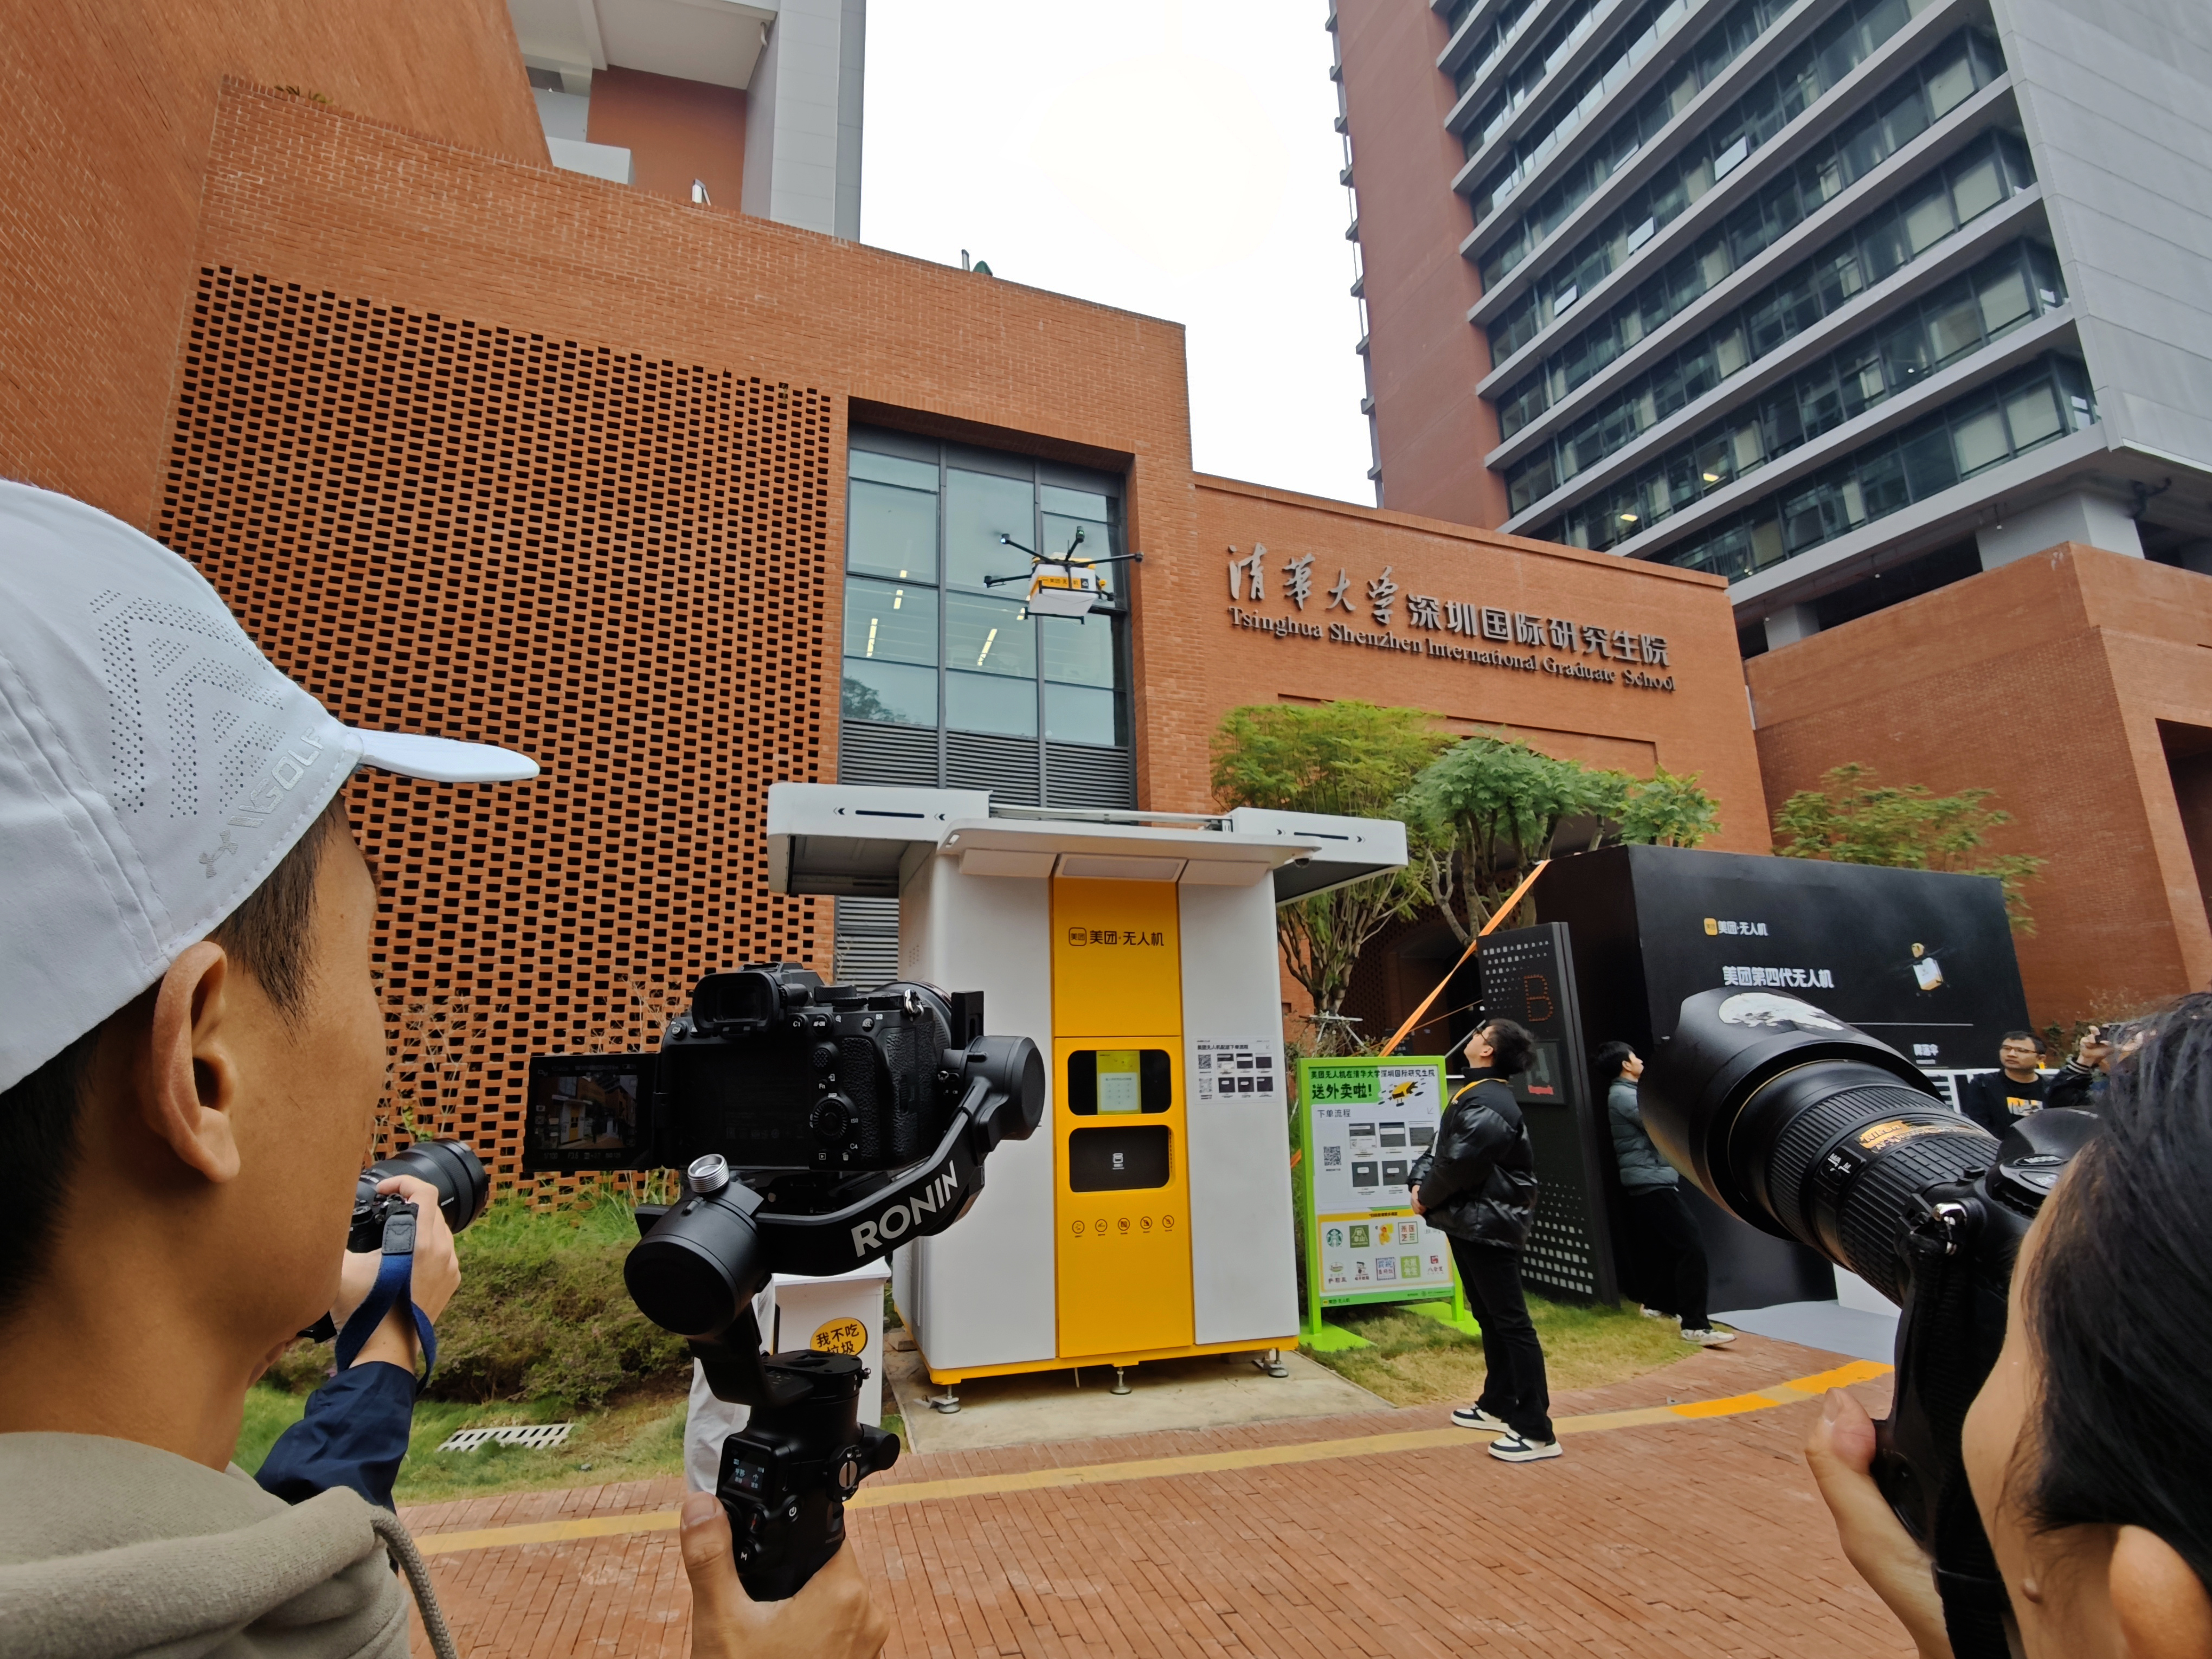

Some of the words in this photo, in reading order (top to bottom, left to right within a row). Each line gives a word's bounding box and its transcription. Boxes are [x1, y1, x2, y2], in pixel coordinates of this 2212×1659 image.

[1229, 606, 1323, 638] Tsinghua
[1329, 622, 1422, 653] Shenzhen
[1426, 638, 1539, 671] International
[1542, 657, 1616, 682] Graduate
[1622, 669, 1676, 691] School
[1090, 930, 1164, 946] 美团·无人机
[1722, 966, 1835, 988] 美团第四代无人机
[1312, 1083, 1372, 1099] 送外卖啦!
[1317, 1109, 1351, 1118] 下单流程
[1863, 1124, 1901, 1143] Nikon
[851, 1160, 958, 1258] RONIN
[816, 1323, 859, 1348] 我不吃
[741, 1552, 747, 1561] M
